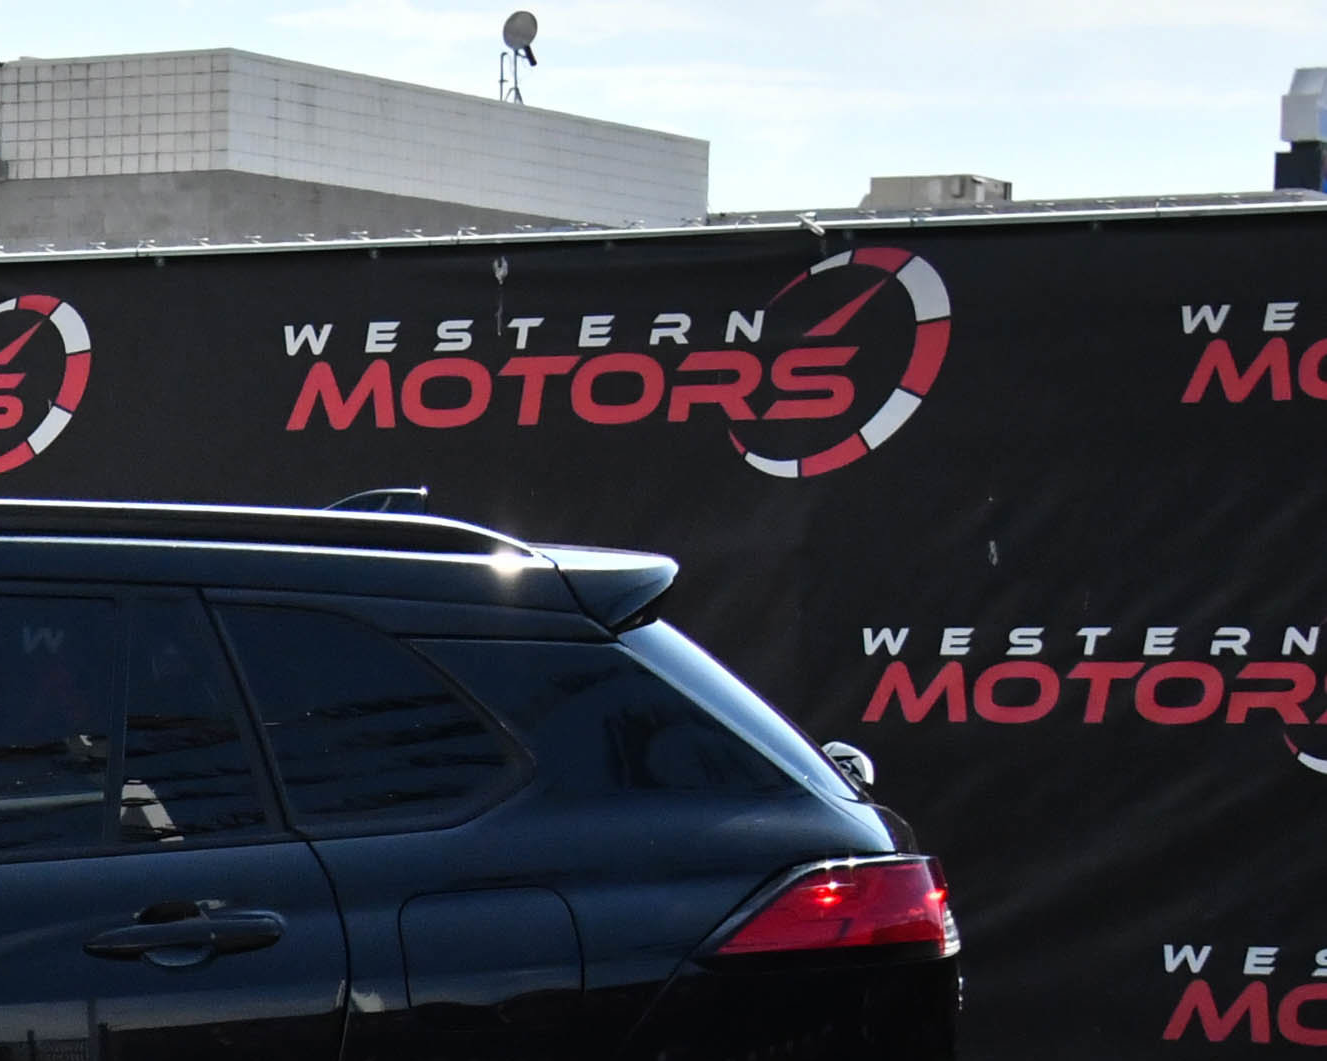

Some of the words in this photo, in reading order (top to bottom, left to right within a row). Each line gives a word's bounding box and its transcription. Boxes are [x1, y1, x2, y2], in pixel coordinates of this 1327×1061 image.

[284, 310, 765, 357] WESTERN
[286, 346, 859, 431] MOTORS
[862, 626, 1321, 656] WESTERN
[862, 660, 1327, 725] MOTOR
